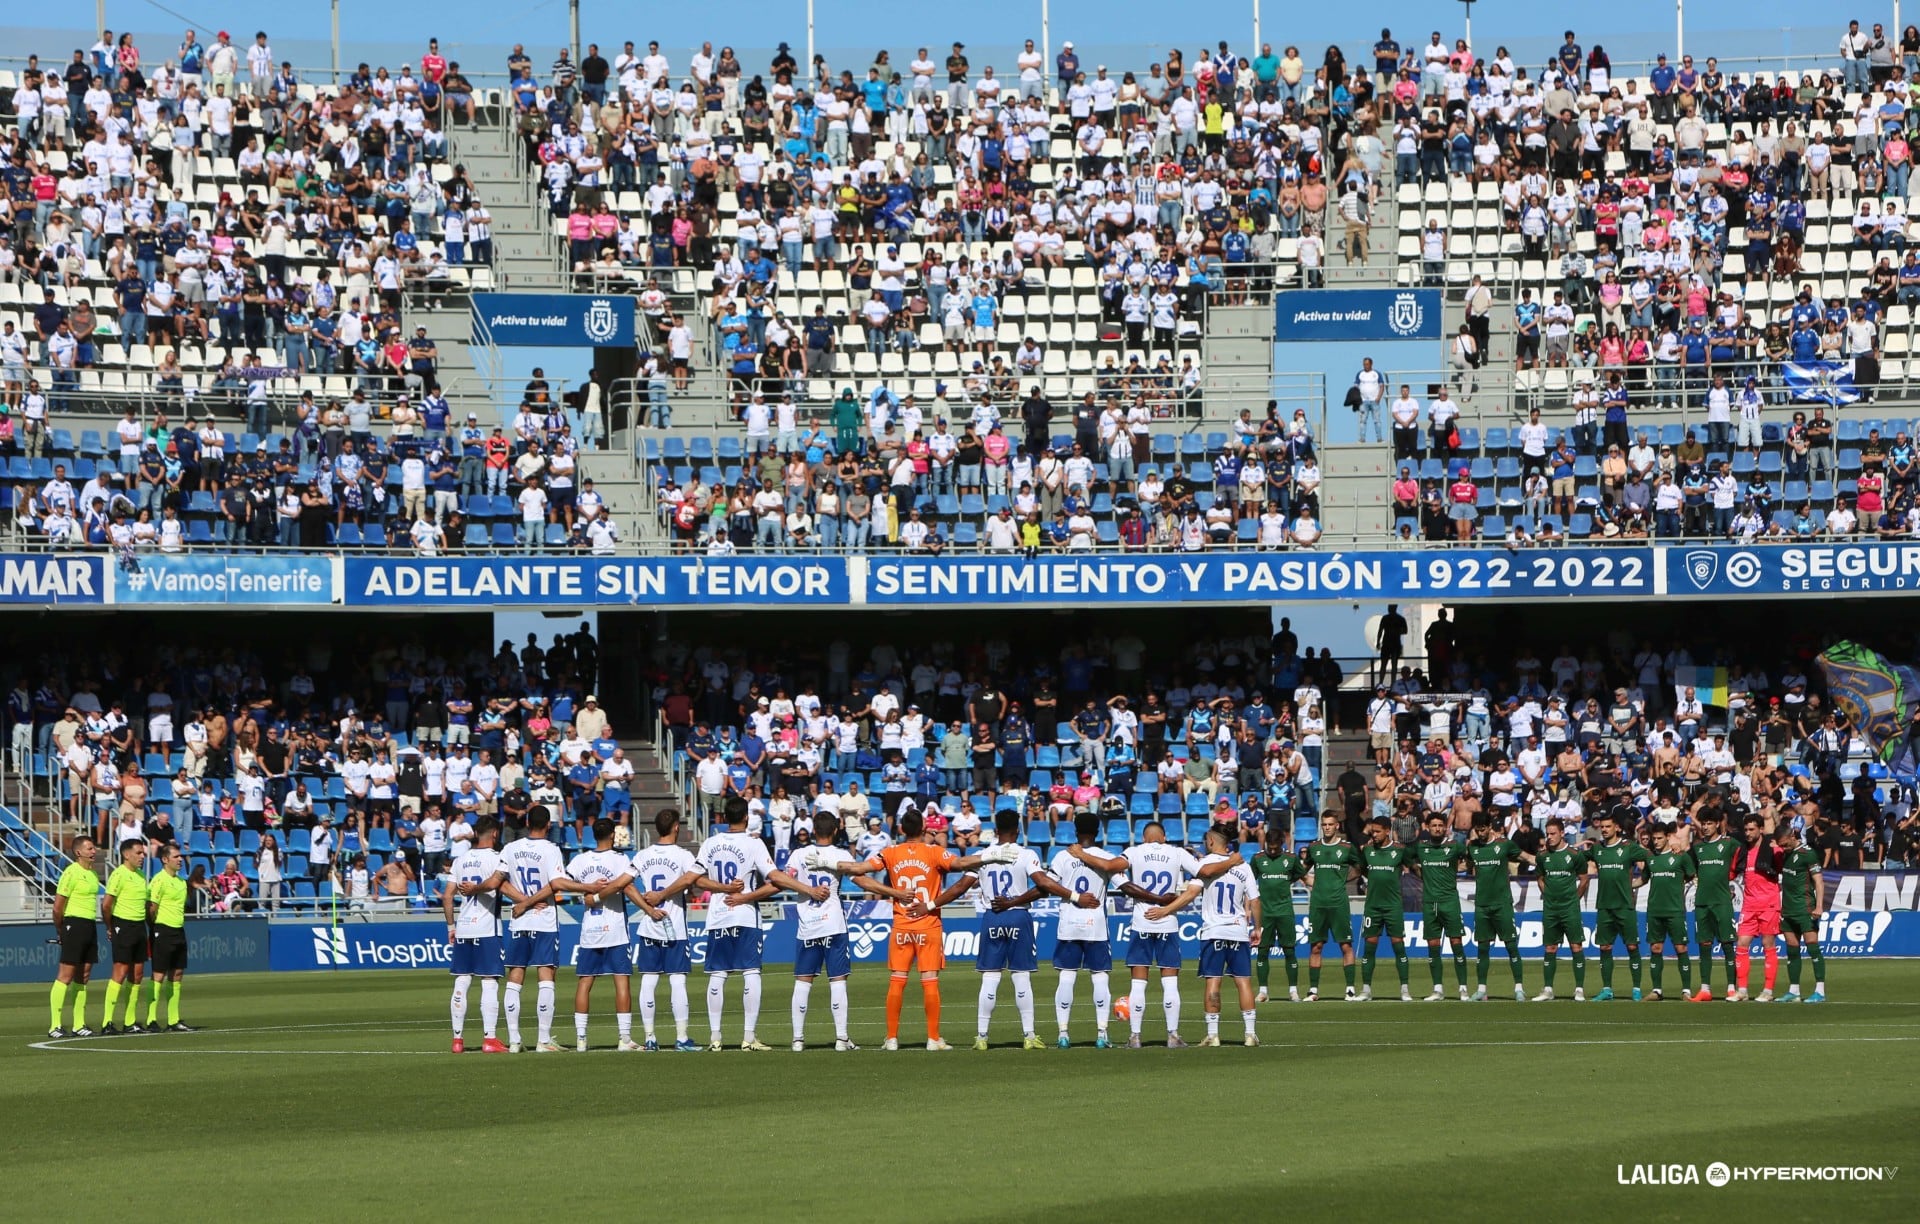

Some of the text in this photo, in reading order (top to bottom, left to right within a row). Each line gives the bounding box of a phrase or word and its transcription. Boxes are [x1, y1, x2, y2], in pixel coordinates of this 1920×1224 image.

[491, 315, 568, 328] ¡Activa tu vida!
[1293, 310, 1372, 324] ¡Activa tu vida!
[875, 554, 1643, 594] SENTIMIENTO Y PASIÓN 1922-2022
[1781, 547, 1920, 578] SEGUR
[0, 560, 95, 596] MAR
[127, 568, 322, 593] #VamosTenerife
[364, 565, 830, 596] ADELANTE SIN TEMOR
[1144, 853, 1170, 863] MELLOT
[714, 860, 738, 885] 18
[988, 870, 1013, 898] 12
[1141, 870, 1173, 896] 22
[1215, 881, 1236, 915] 11
[1830, 875, 1920, 911] AN
[895, 932, 927, 945] EAVE
[988, 927, 1020, 940] EAVE
[356, 938, 453, 967] Hospite
